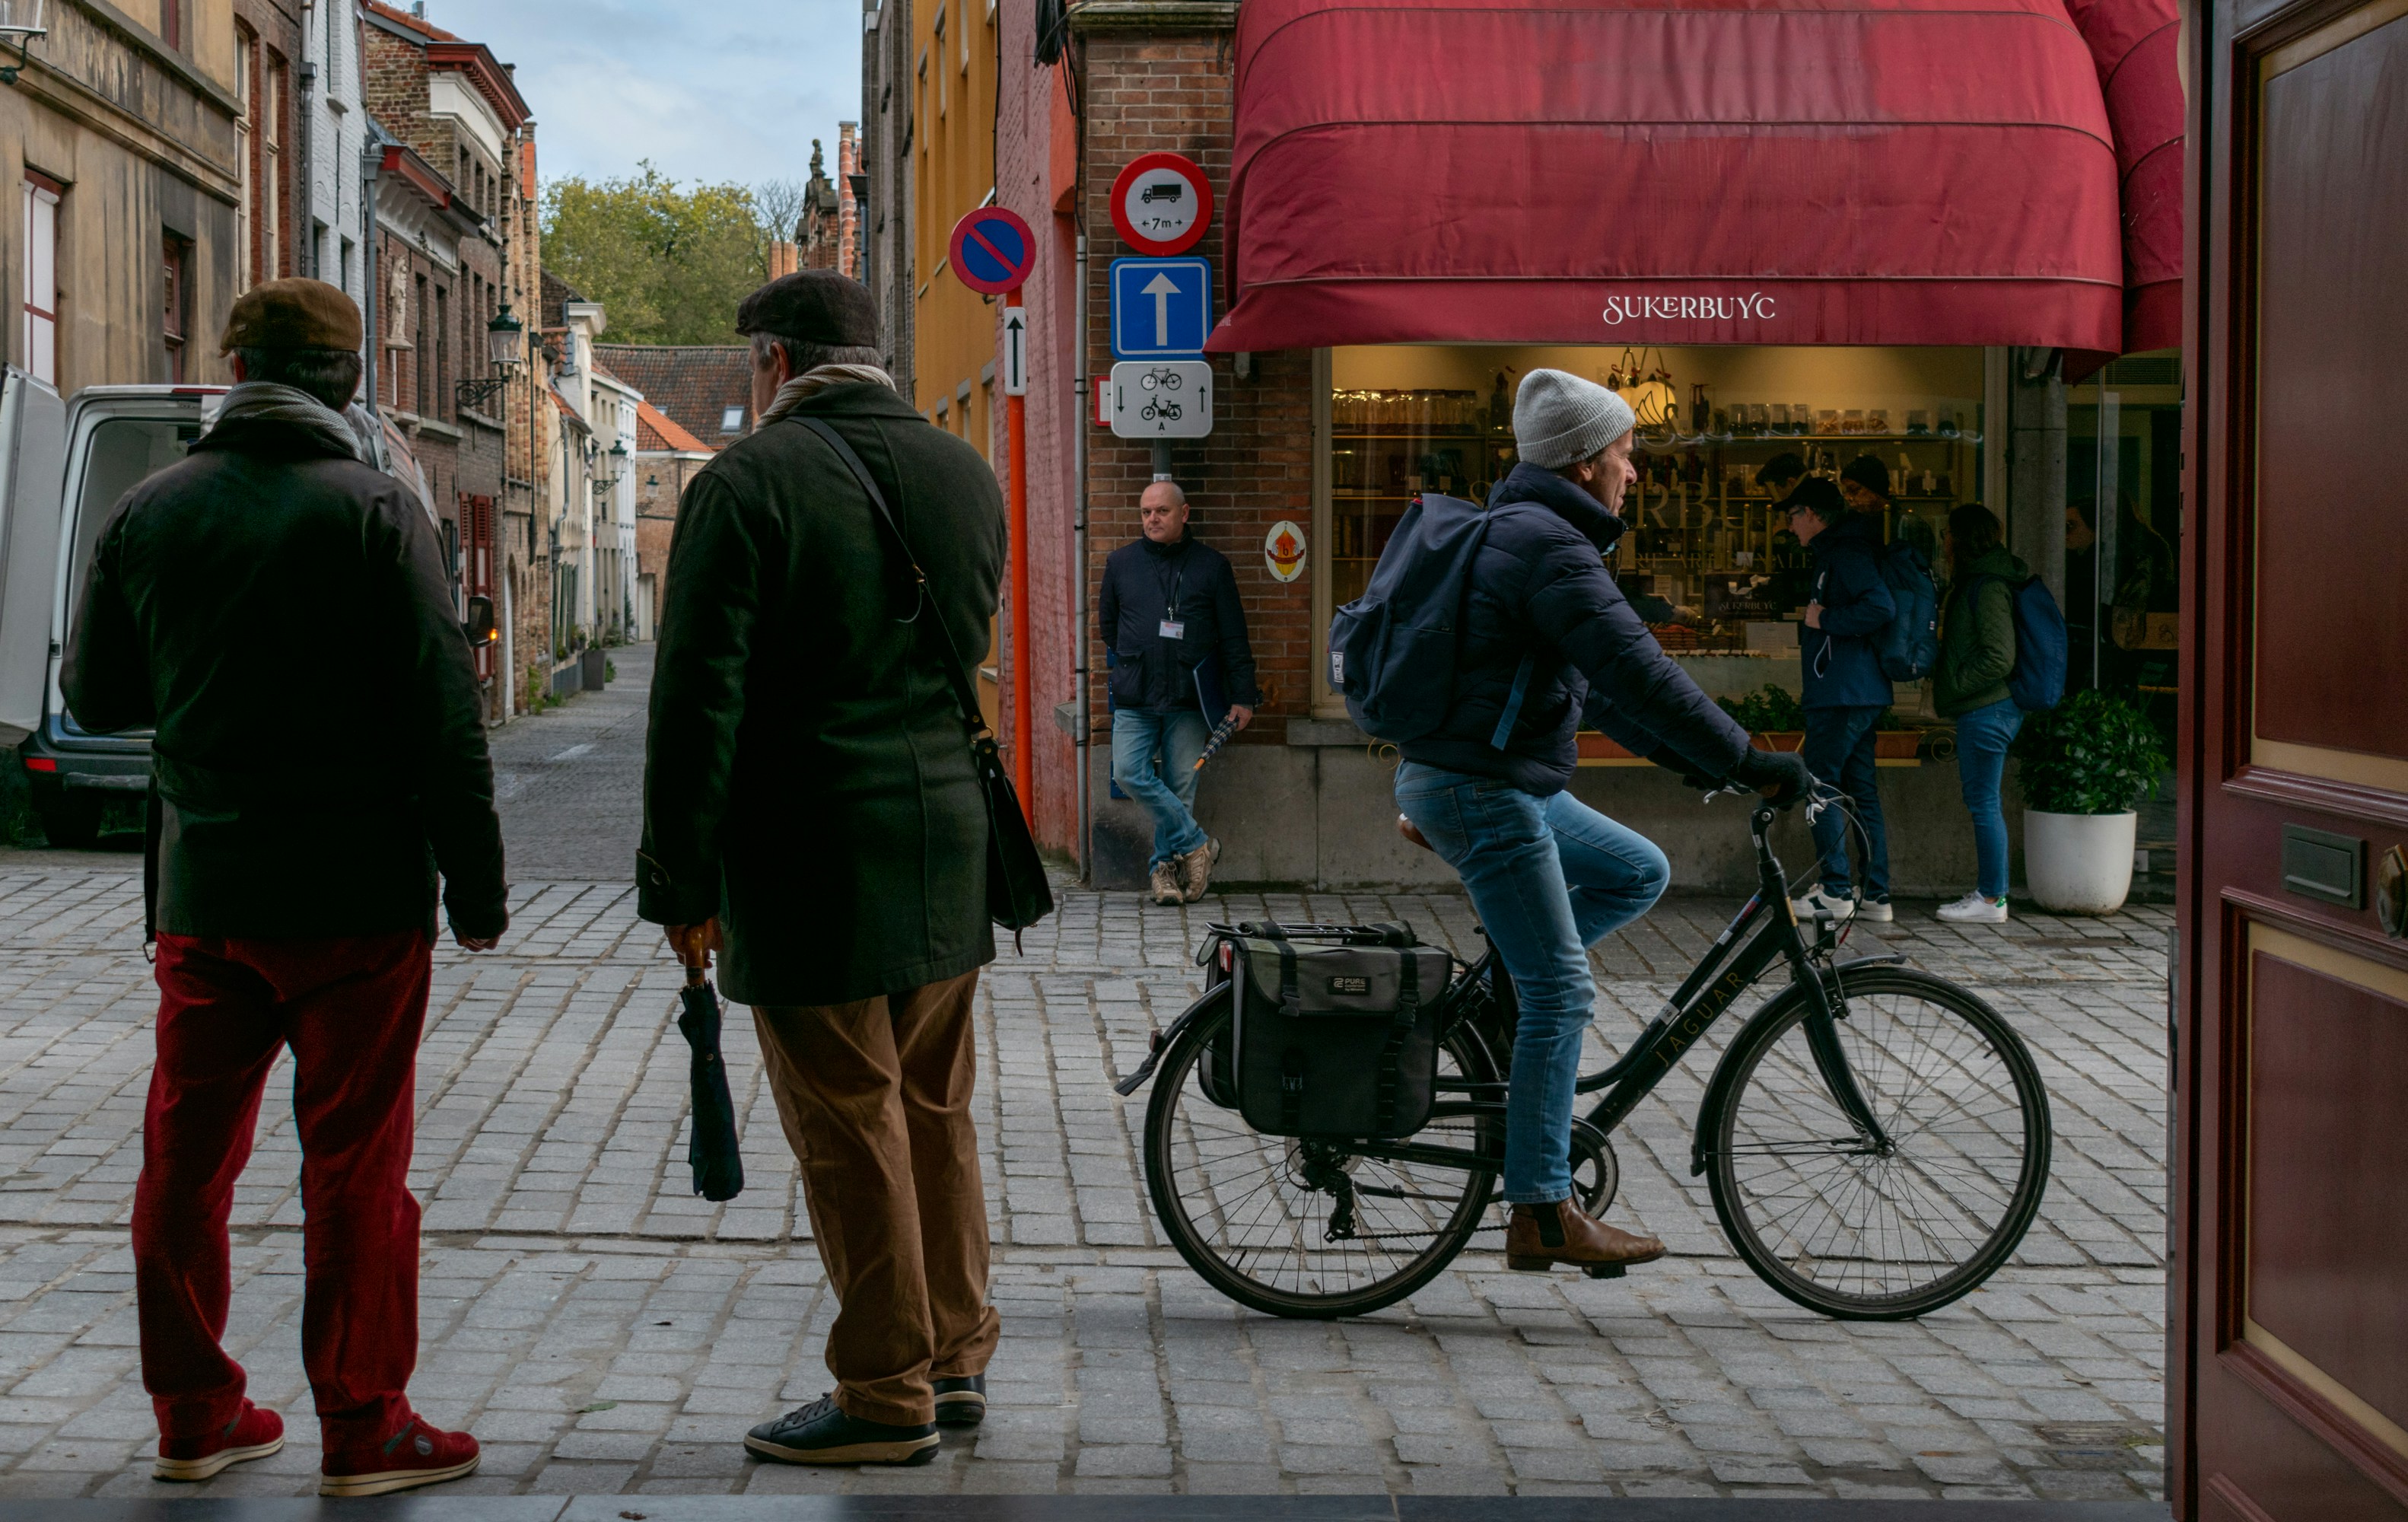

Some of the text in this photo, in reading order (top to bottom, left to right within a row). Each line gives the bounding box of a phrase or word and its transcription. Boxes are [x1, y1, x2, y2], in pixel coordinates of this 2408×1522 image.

[1152, 218, 1172, 231] 7m
[1603, 291, 1776, 326] SUKERBUYC
[1158, 421, 1166, 431] A
[1656, 971, 1745, 1068] JAGUAR
